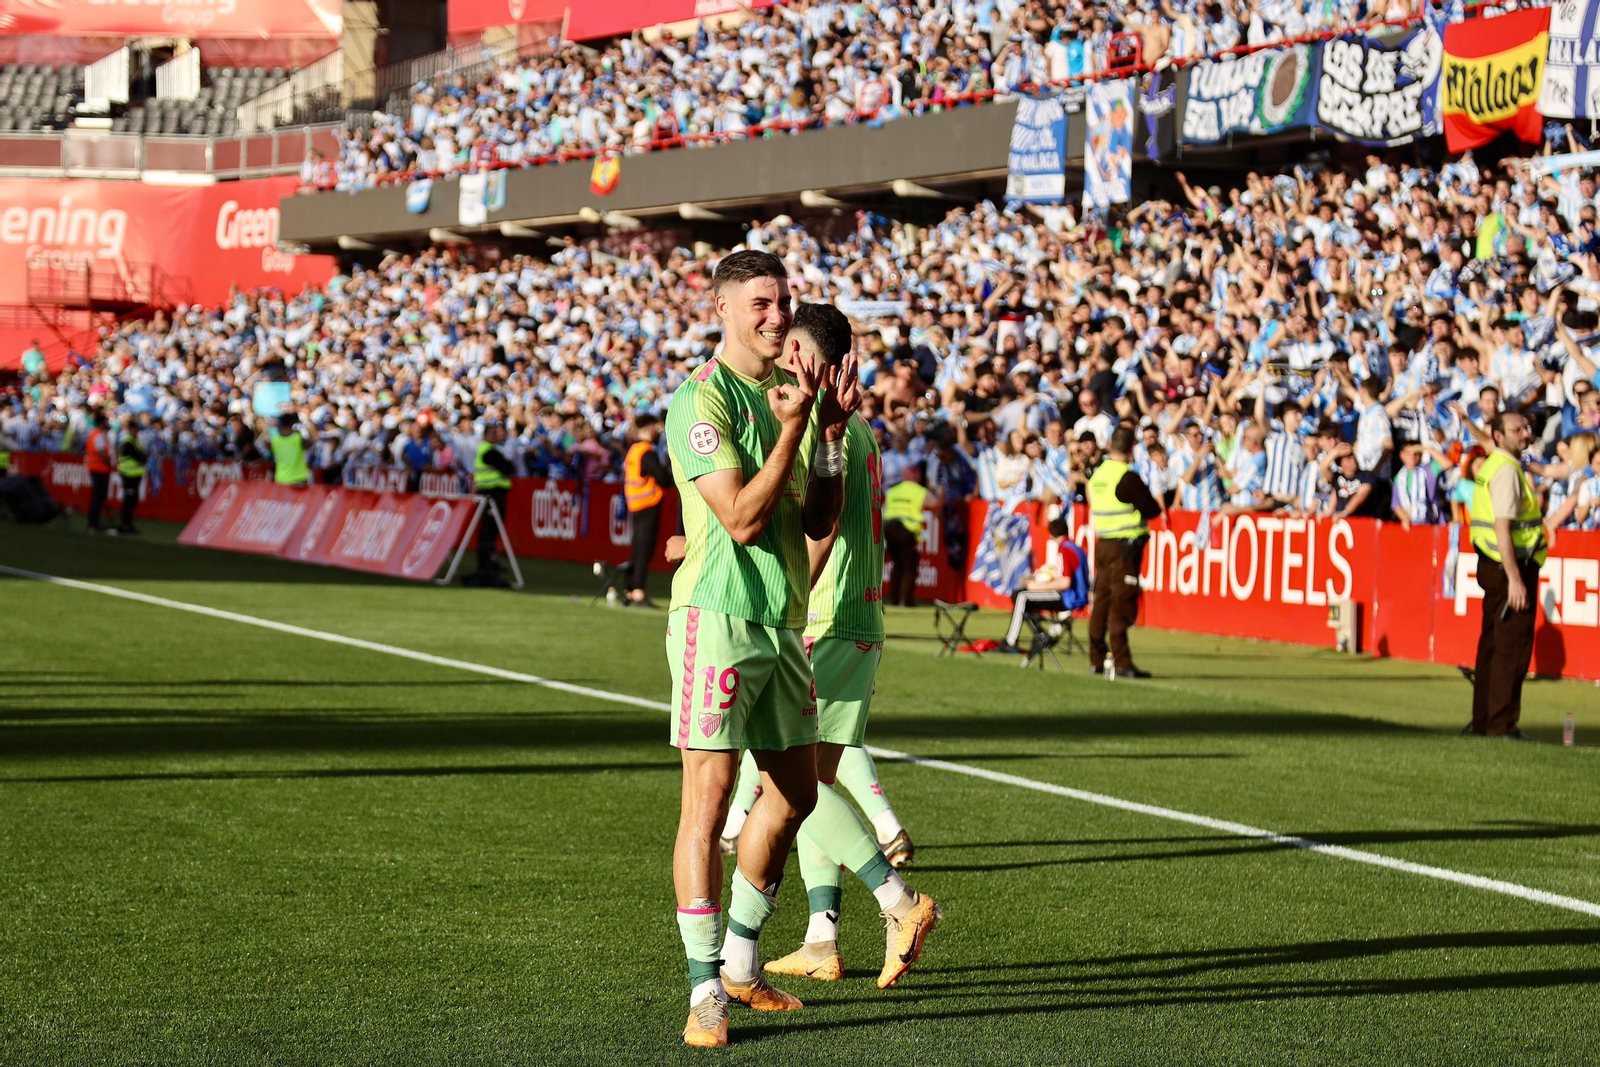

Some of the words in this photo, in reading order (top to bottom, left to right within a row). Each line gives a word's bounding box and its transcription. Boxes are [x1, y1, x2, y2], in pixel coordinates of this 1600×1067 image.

[161, 5, 217, 27] Group
[1323, 40, 1364, 93] LOS
[1550, 38, 1600, 66] MALA
[26, 244, 94, 275] Group
[698, 666, 740, 710] 19
